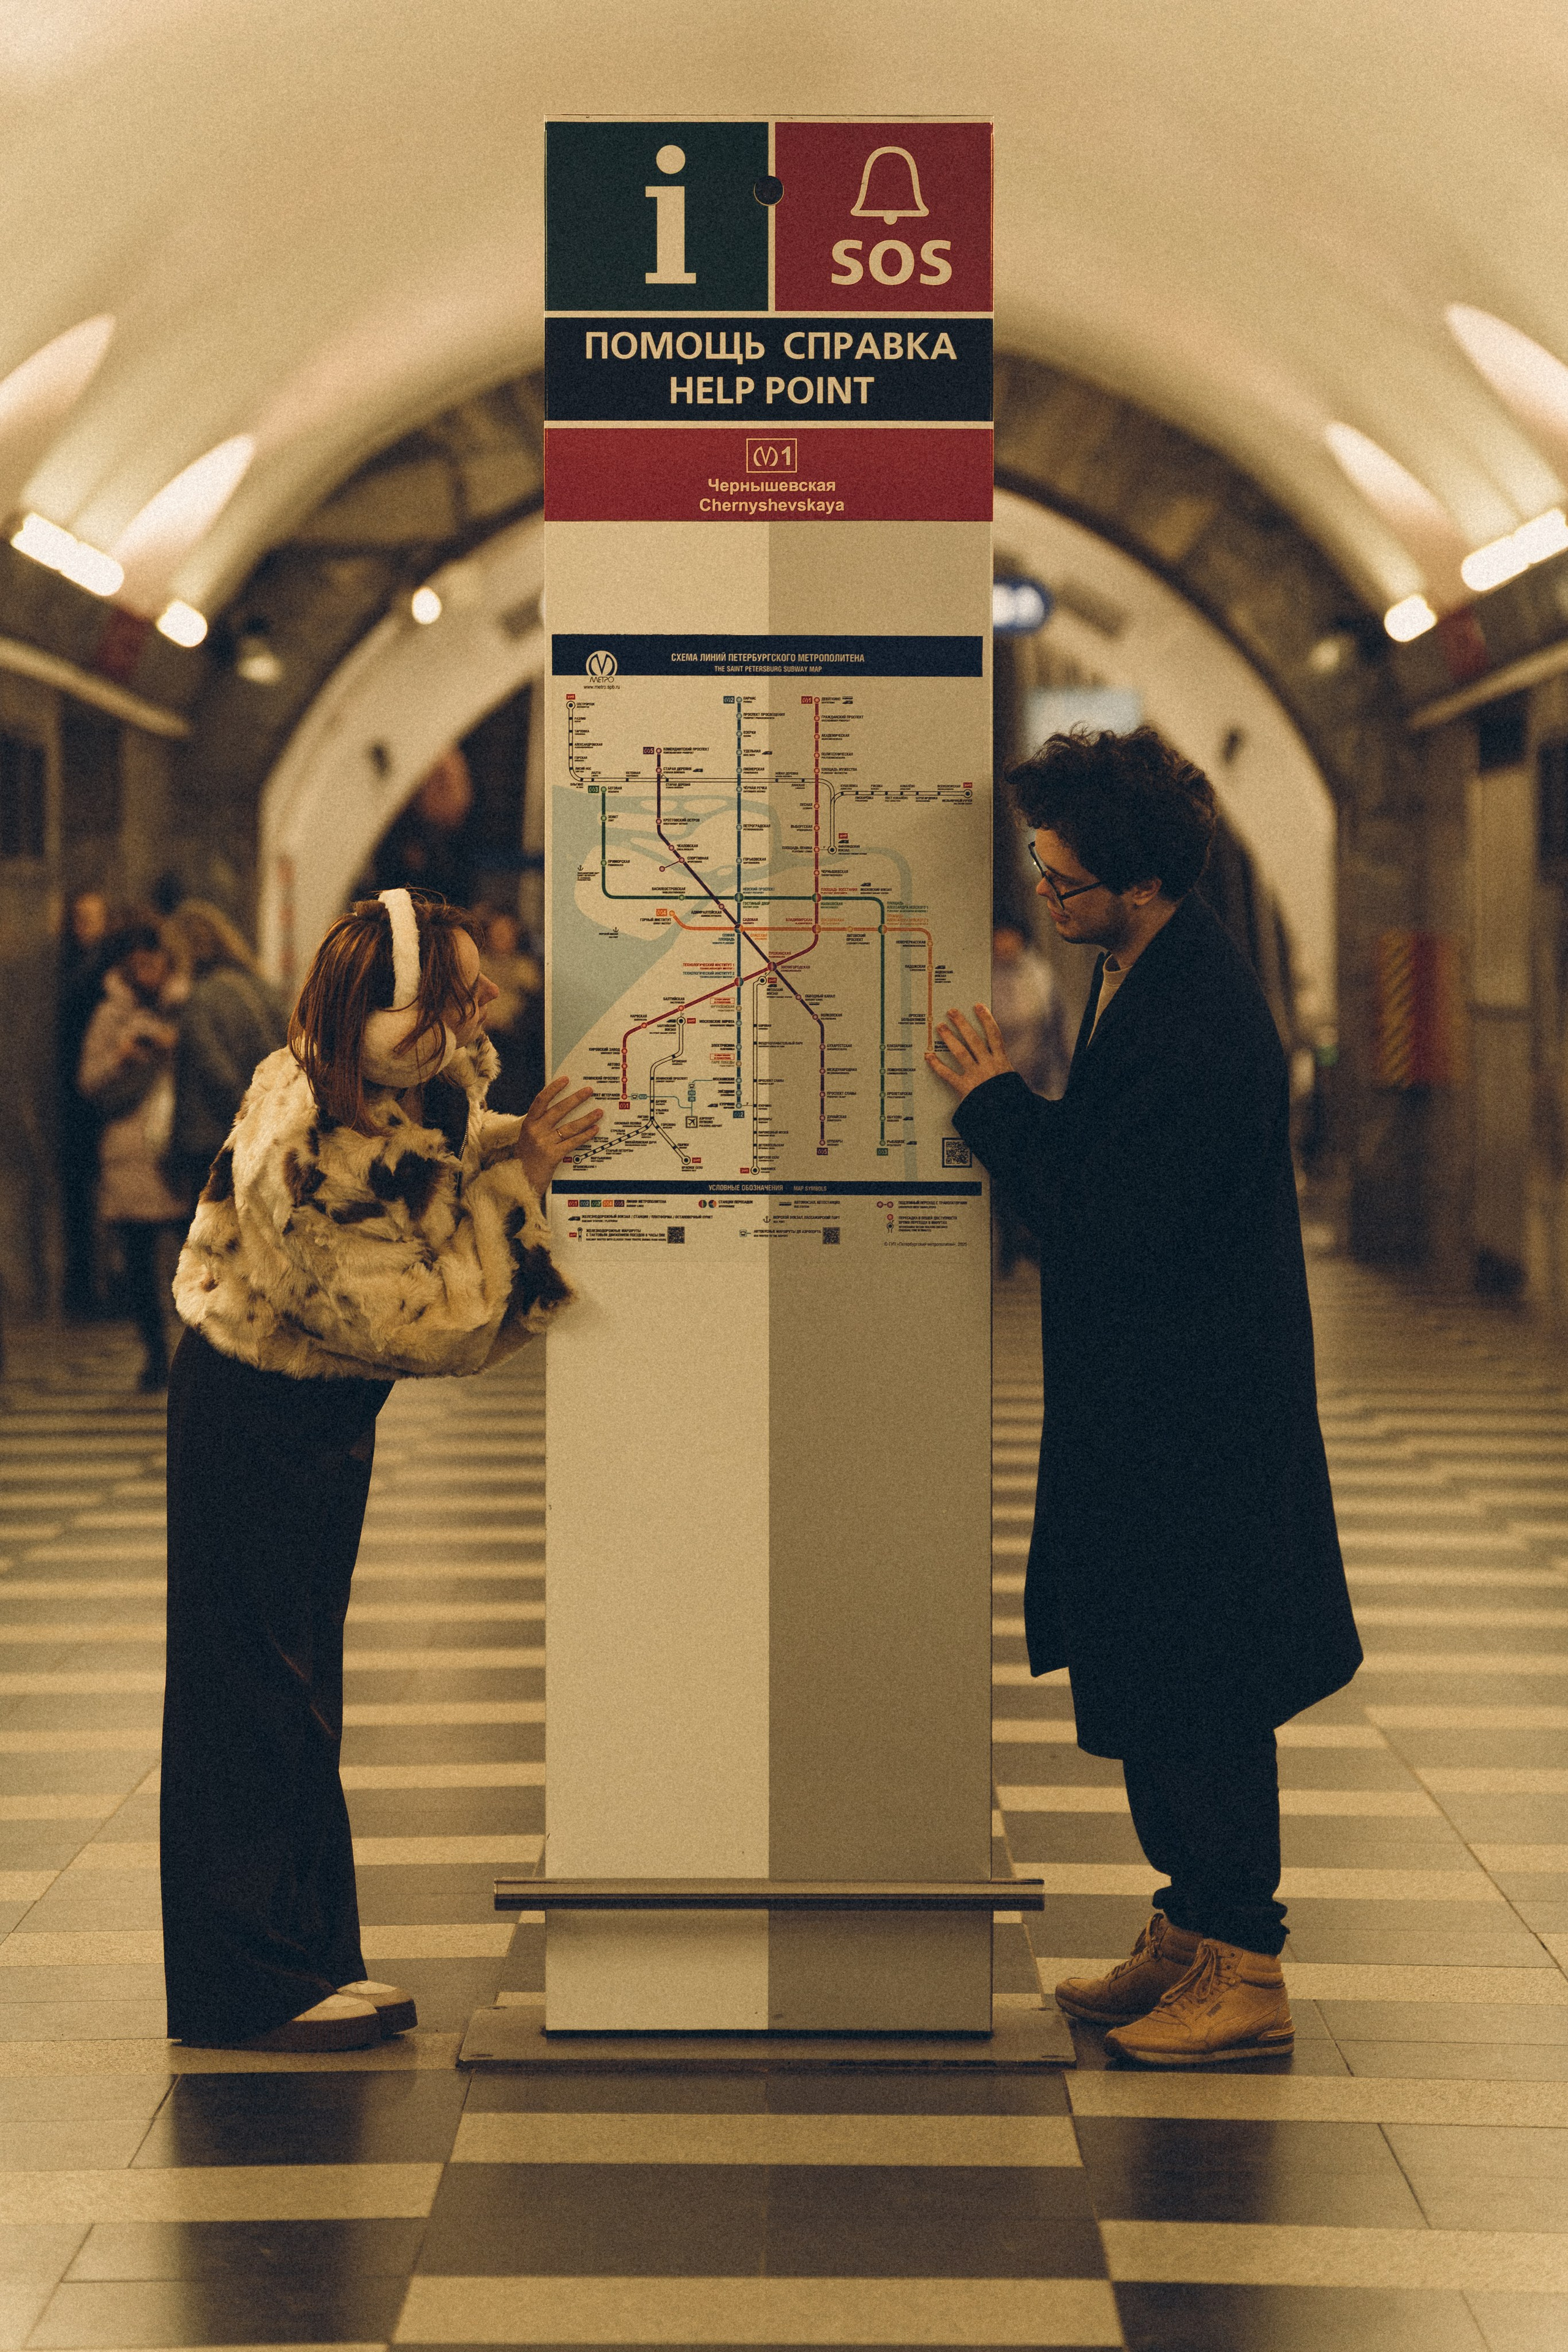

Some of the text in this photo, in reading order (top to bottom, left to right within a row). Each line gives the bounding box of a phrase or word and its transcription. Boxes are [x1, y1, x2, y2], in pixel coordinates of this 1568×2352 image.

[831, 239, 953, 285] SOS
[585, 331, 957, 364] ПОМОЩЬ СПРАВКА
[670, 375, 875, 404] HELP POINT
[708, 478, 836, 495] Чернышевская
[699, 497, 845, 514] Chernyshevskaya
[700, 652, 726, 662] ЛИНИЙ
